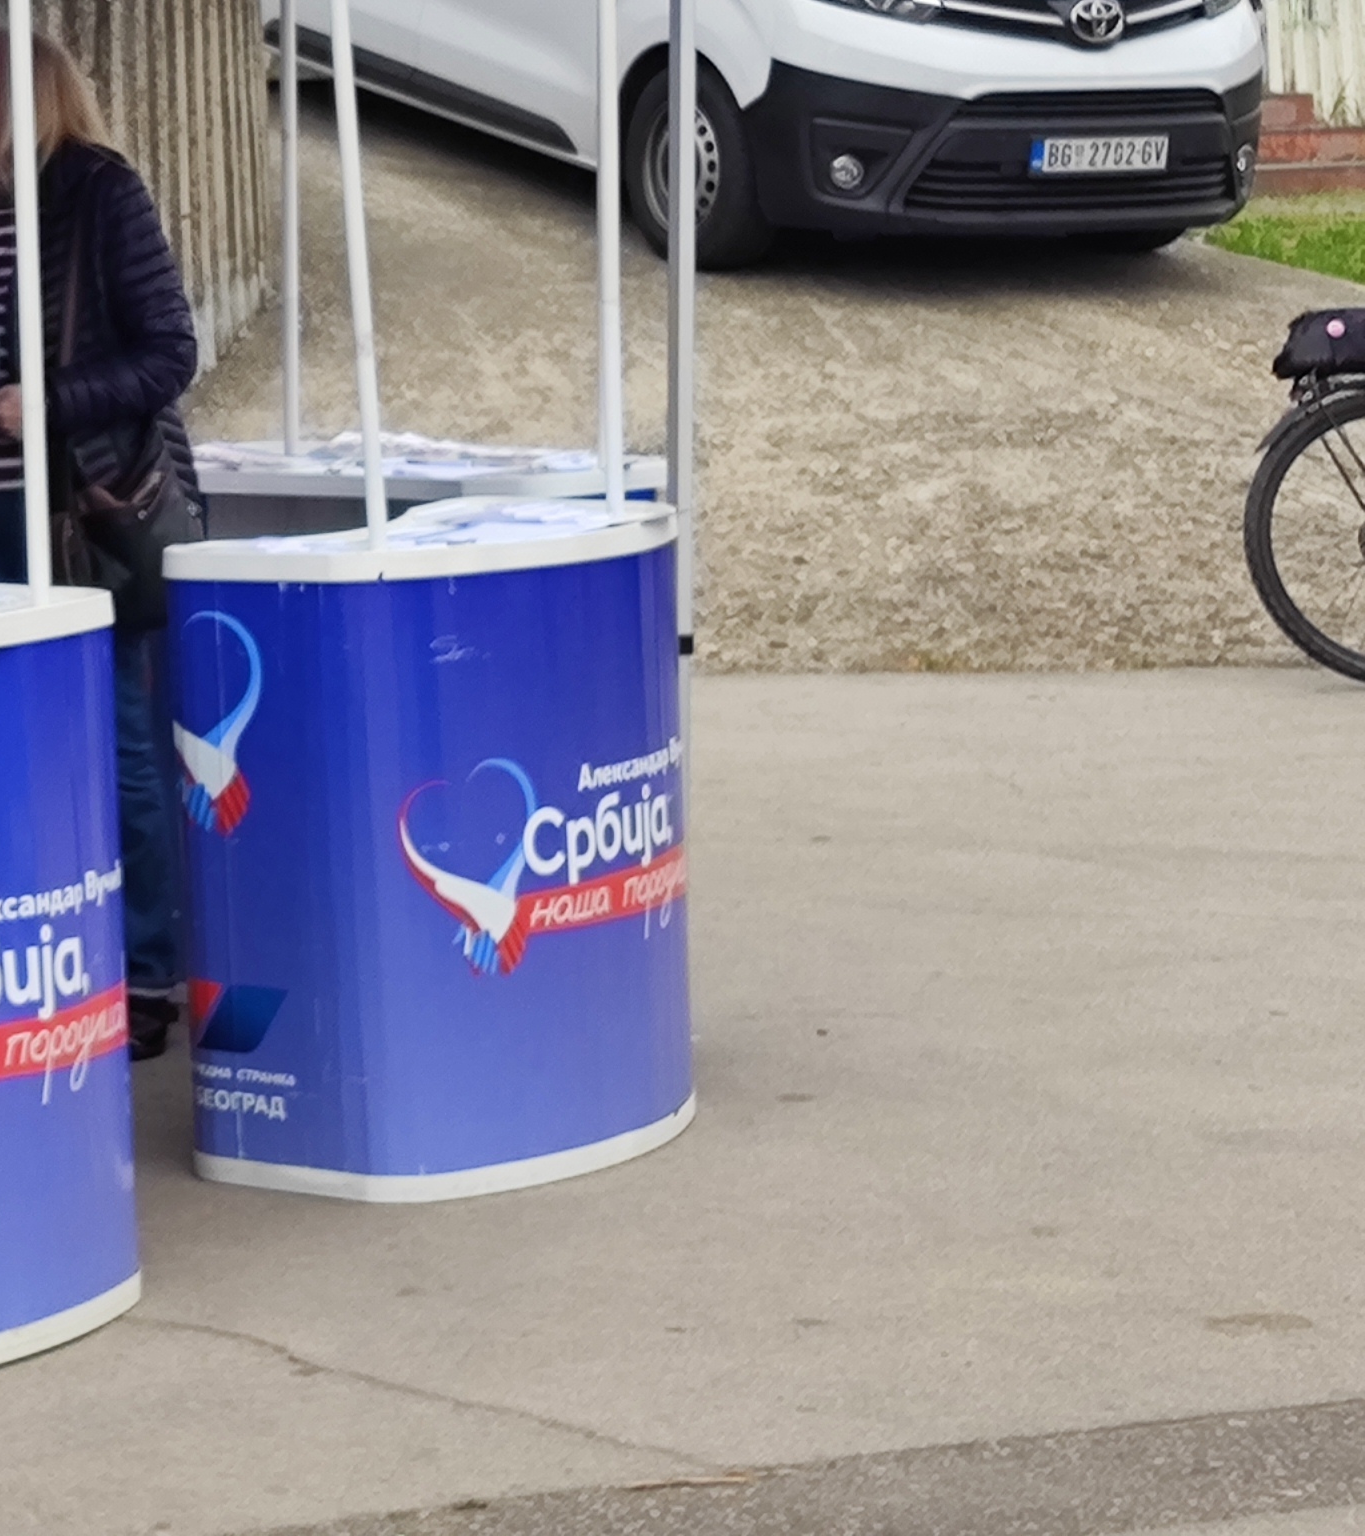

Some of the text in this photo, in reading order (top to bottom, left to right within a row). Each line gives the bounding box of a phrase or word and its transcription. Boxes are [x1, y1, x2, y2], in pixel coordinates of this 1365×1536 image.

[1048, 143, 1072, 167] BG
[523, 783, 673, 886] Србија,
[530, 885, 610, 928] наша
